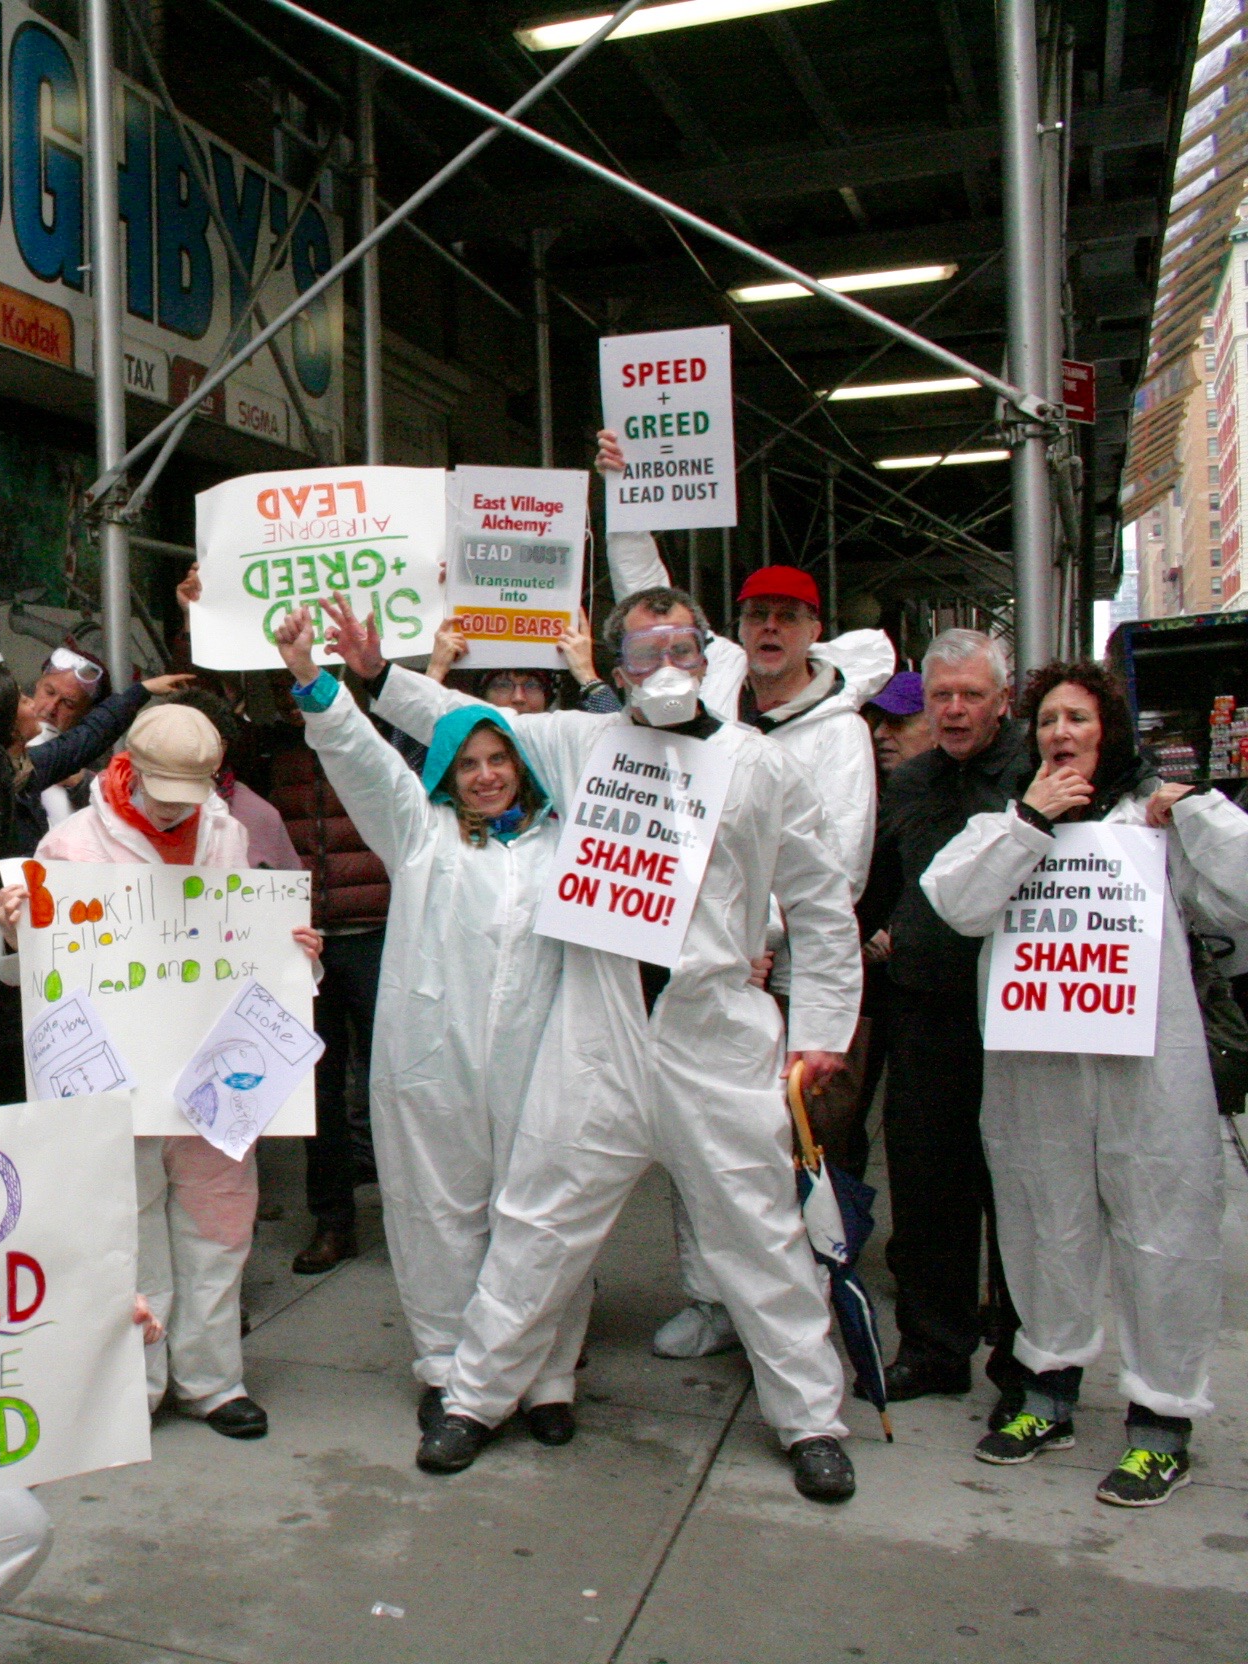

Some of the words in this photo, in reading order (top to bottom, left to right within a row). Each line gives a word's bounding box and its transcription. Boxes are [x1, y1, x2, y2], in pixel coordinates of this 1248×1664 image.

[1, 303, 61, 358] Kodak
[622, 357, 707, 388] SPEED
[657, 392, 671, 405] +
[238, 401, 278, 433] SIGMA
[625, 411, 710, 440] GREED
[623, 458, 714, 480] AIRBORNE
[257, 480, 367, 521] LEAD
[473, 494, 506, 510] East
[511, 496, 564, 517] Village
[619, 486, 664, 504] LEAD
[672, 482, 719, 501] DUST
[263, 514, 391, 544] AIRBORNE
[481, 514, 552, 536] Alchemy:
[466, 543, 512, 561] LEAD
[519, 546, 570, 565] DUST
[475, 575, 555, 589] transmuted
[500, 588, 527, 602] into
[262, 587, 423, 648] SED
[460, 614, 507, 634] GOLD
[514, 616, 563, 637] BARS
[612, 752, 692, 791] Harming
[586, 776, 657, 807] Children
[663, 795, 707, 820] with
[574, 801, 641, 836] LEAD
[647, 819, 698, 849] Dust:
[576, 837, 679, 886] SHAME
[1032, 852, 1122, 878] Harming
[558, 872, 600, 908] ON
[608, 882, 677, 927] YOU!
[1010, 881, 1090, 901] hildren
[1098, 882, 1147, 902] with
[159, 919, 199, 944] the
[219, 921, 252, 942] law
[1004, 908, 1078, 934] LEAD
[1087, 911, 1144, 933] Dust:
[1014, 942, 1130, 974] SHAME
[1001, 981, 1048, 1012] ON
[1058, 981, 1137, 1015] YOU!
